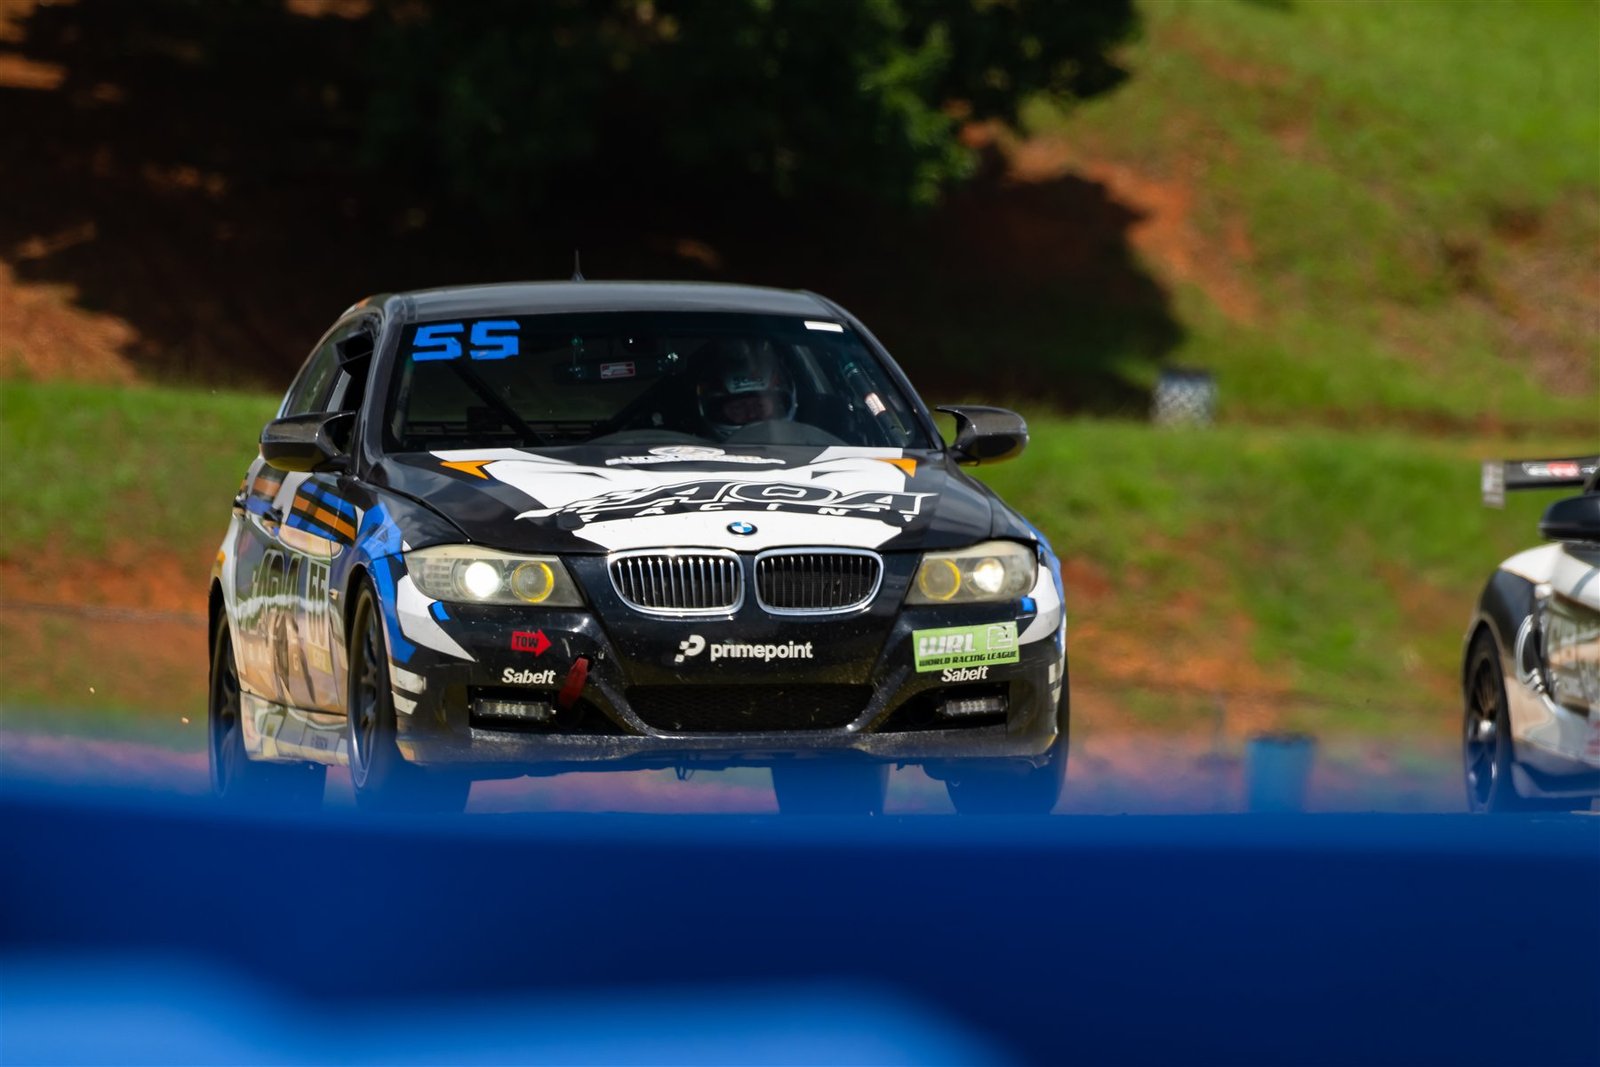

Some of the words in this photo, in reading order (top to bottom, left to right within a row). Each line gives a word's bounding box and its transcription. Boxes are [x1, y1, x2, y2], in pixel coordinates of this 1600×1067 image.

[412, 320, 521, 361] 55
[515, 634, 540, 649] TOW
[918, 632, 977, 658] WRL
[709, 640, 814, 663] primepoint
[918, 657, 950, 668] WORLD
[952, 653, 985, 664] RACING
[986, 649, 1018, 661] LEAGUE
[501, 667, 556, 685] Sabelt
[940, 665, 989, 683] Sabelt
